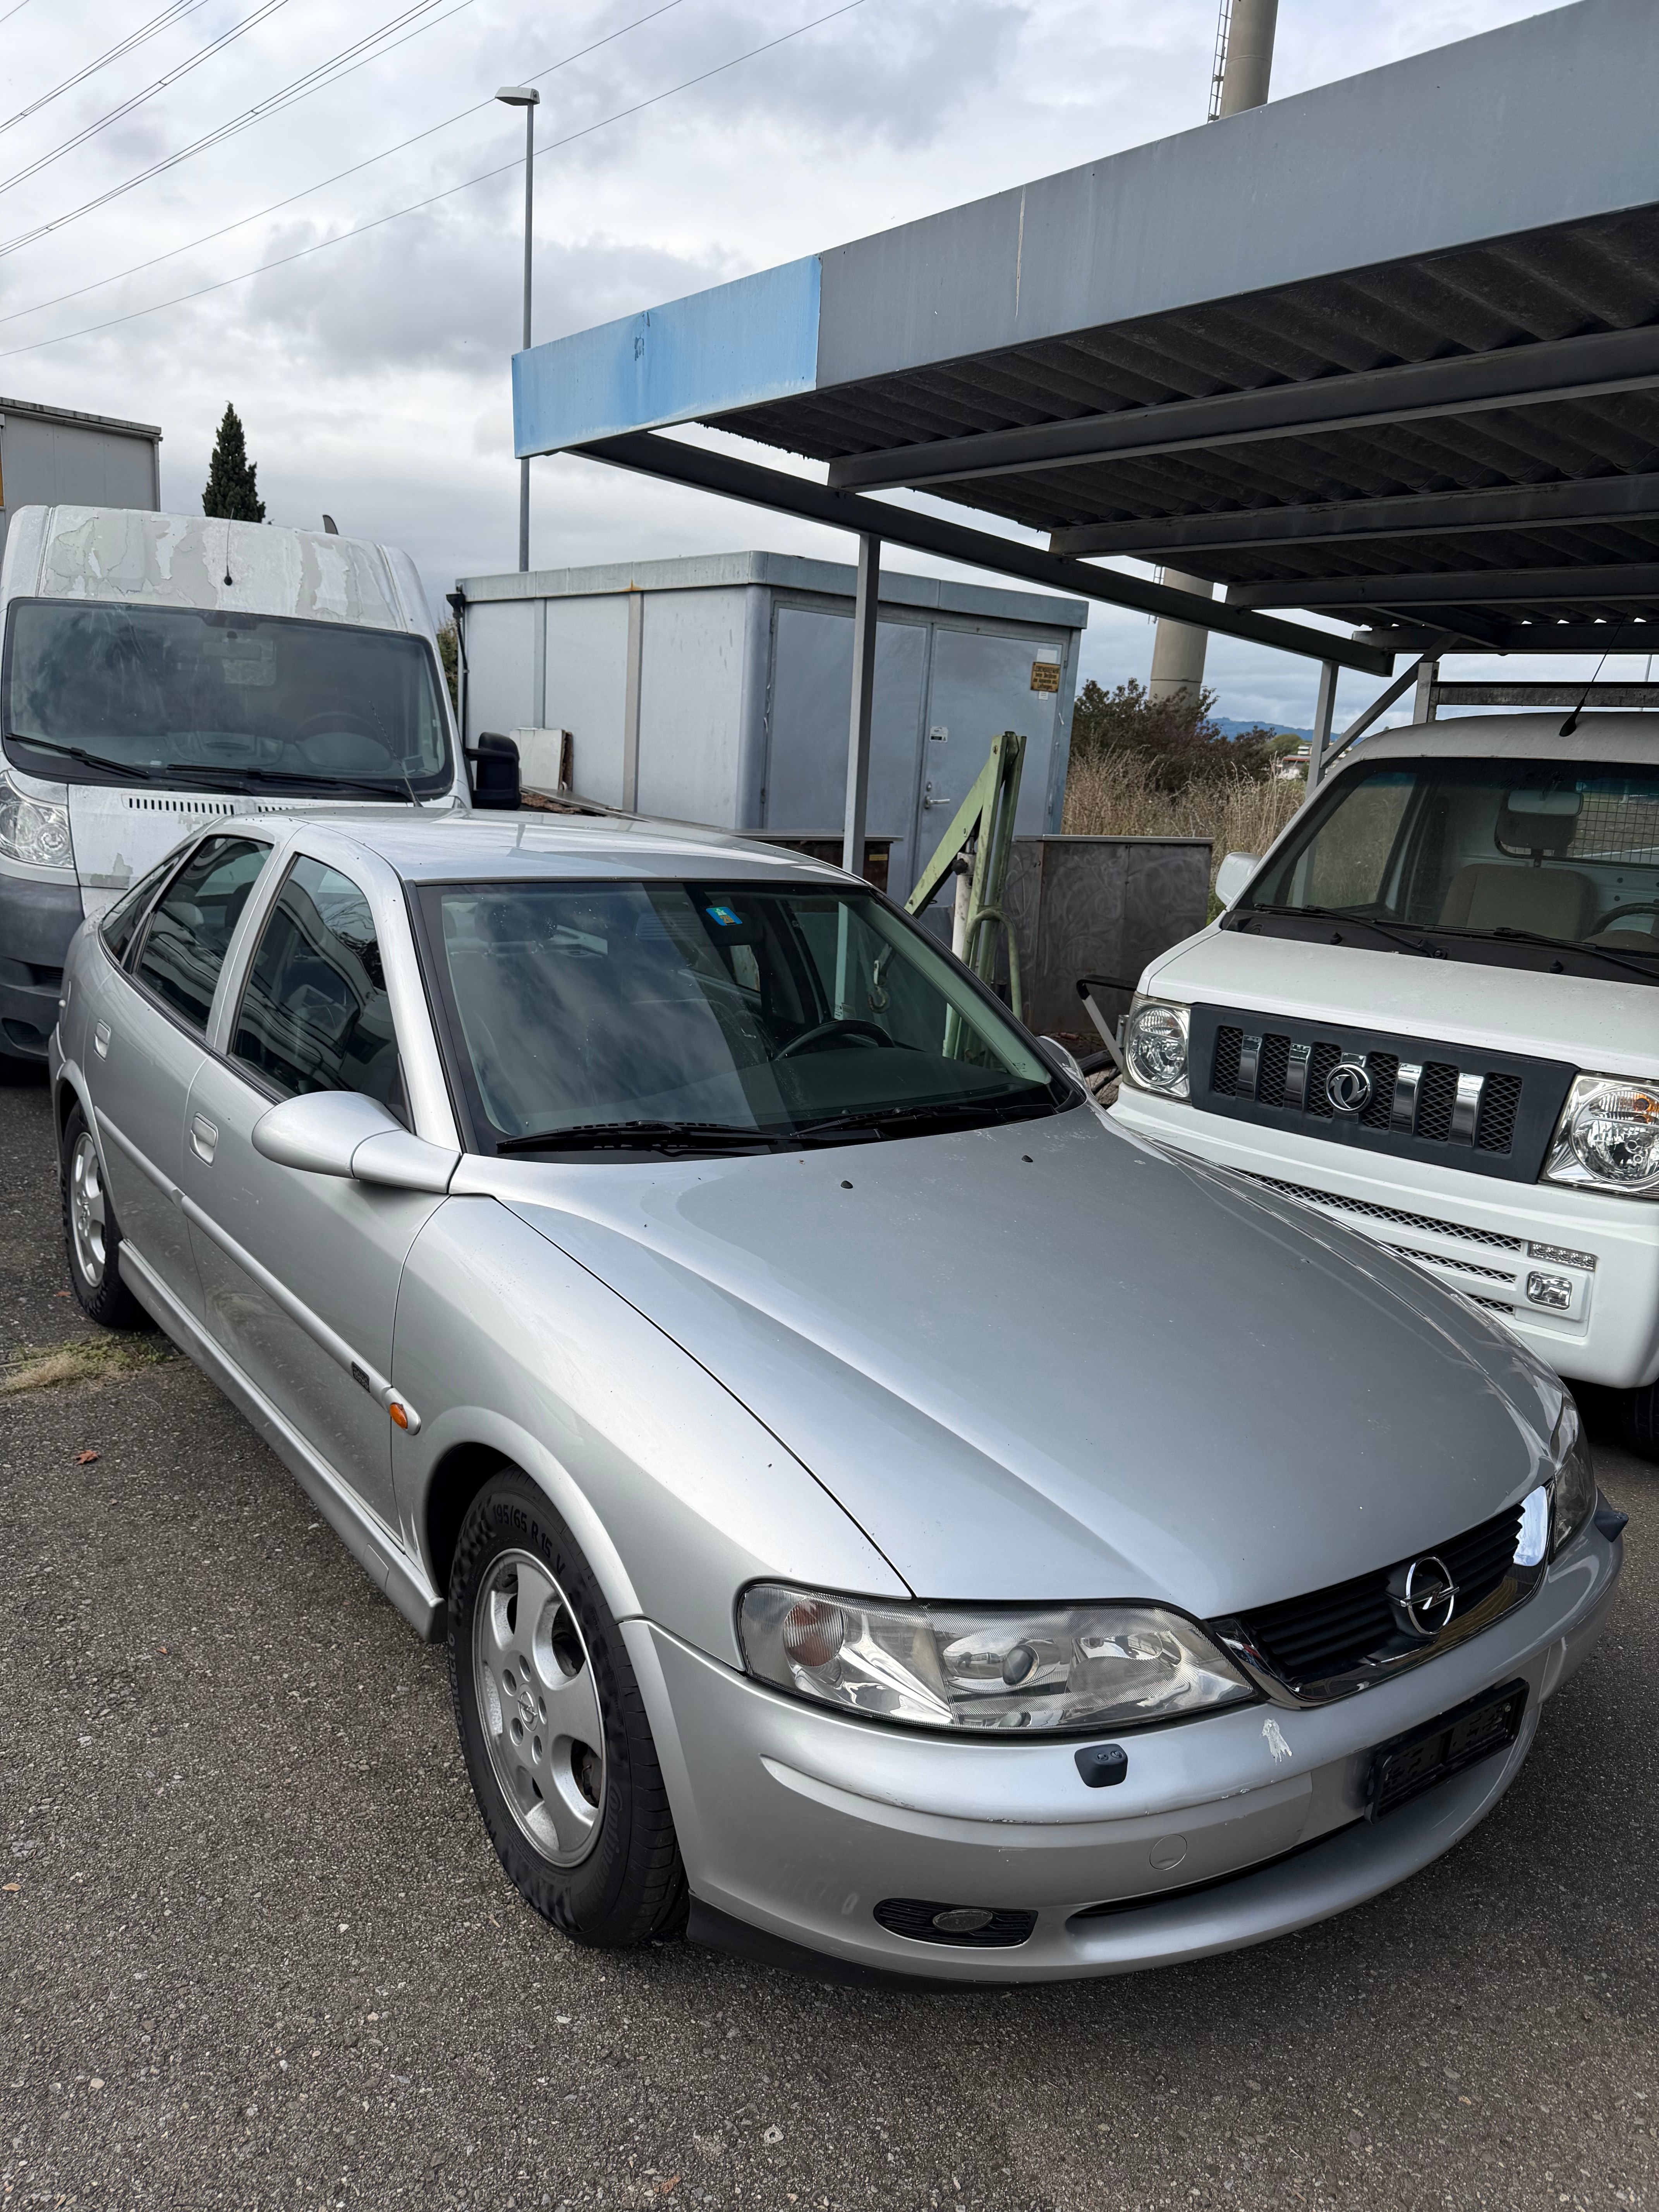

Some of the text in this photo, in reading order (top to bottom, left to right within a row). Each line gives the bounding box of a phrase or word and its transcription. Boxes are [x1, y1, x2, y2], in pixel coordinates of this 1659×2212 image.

[492, 1504, 566, 1575] 195/65 R 15 V
